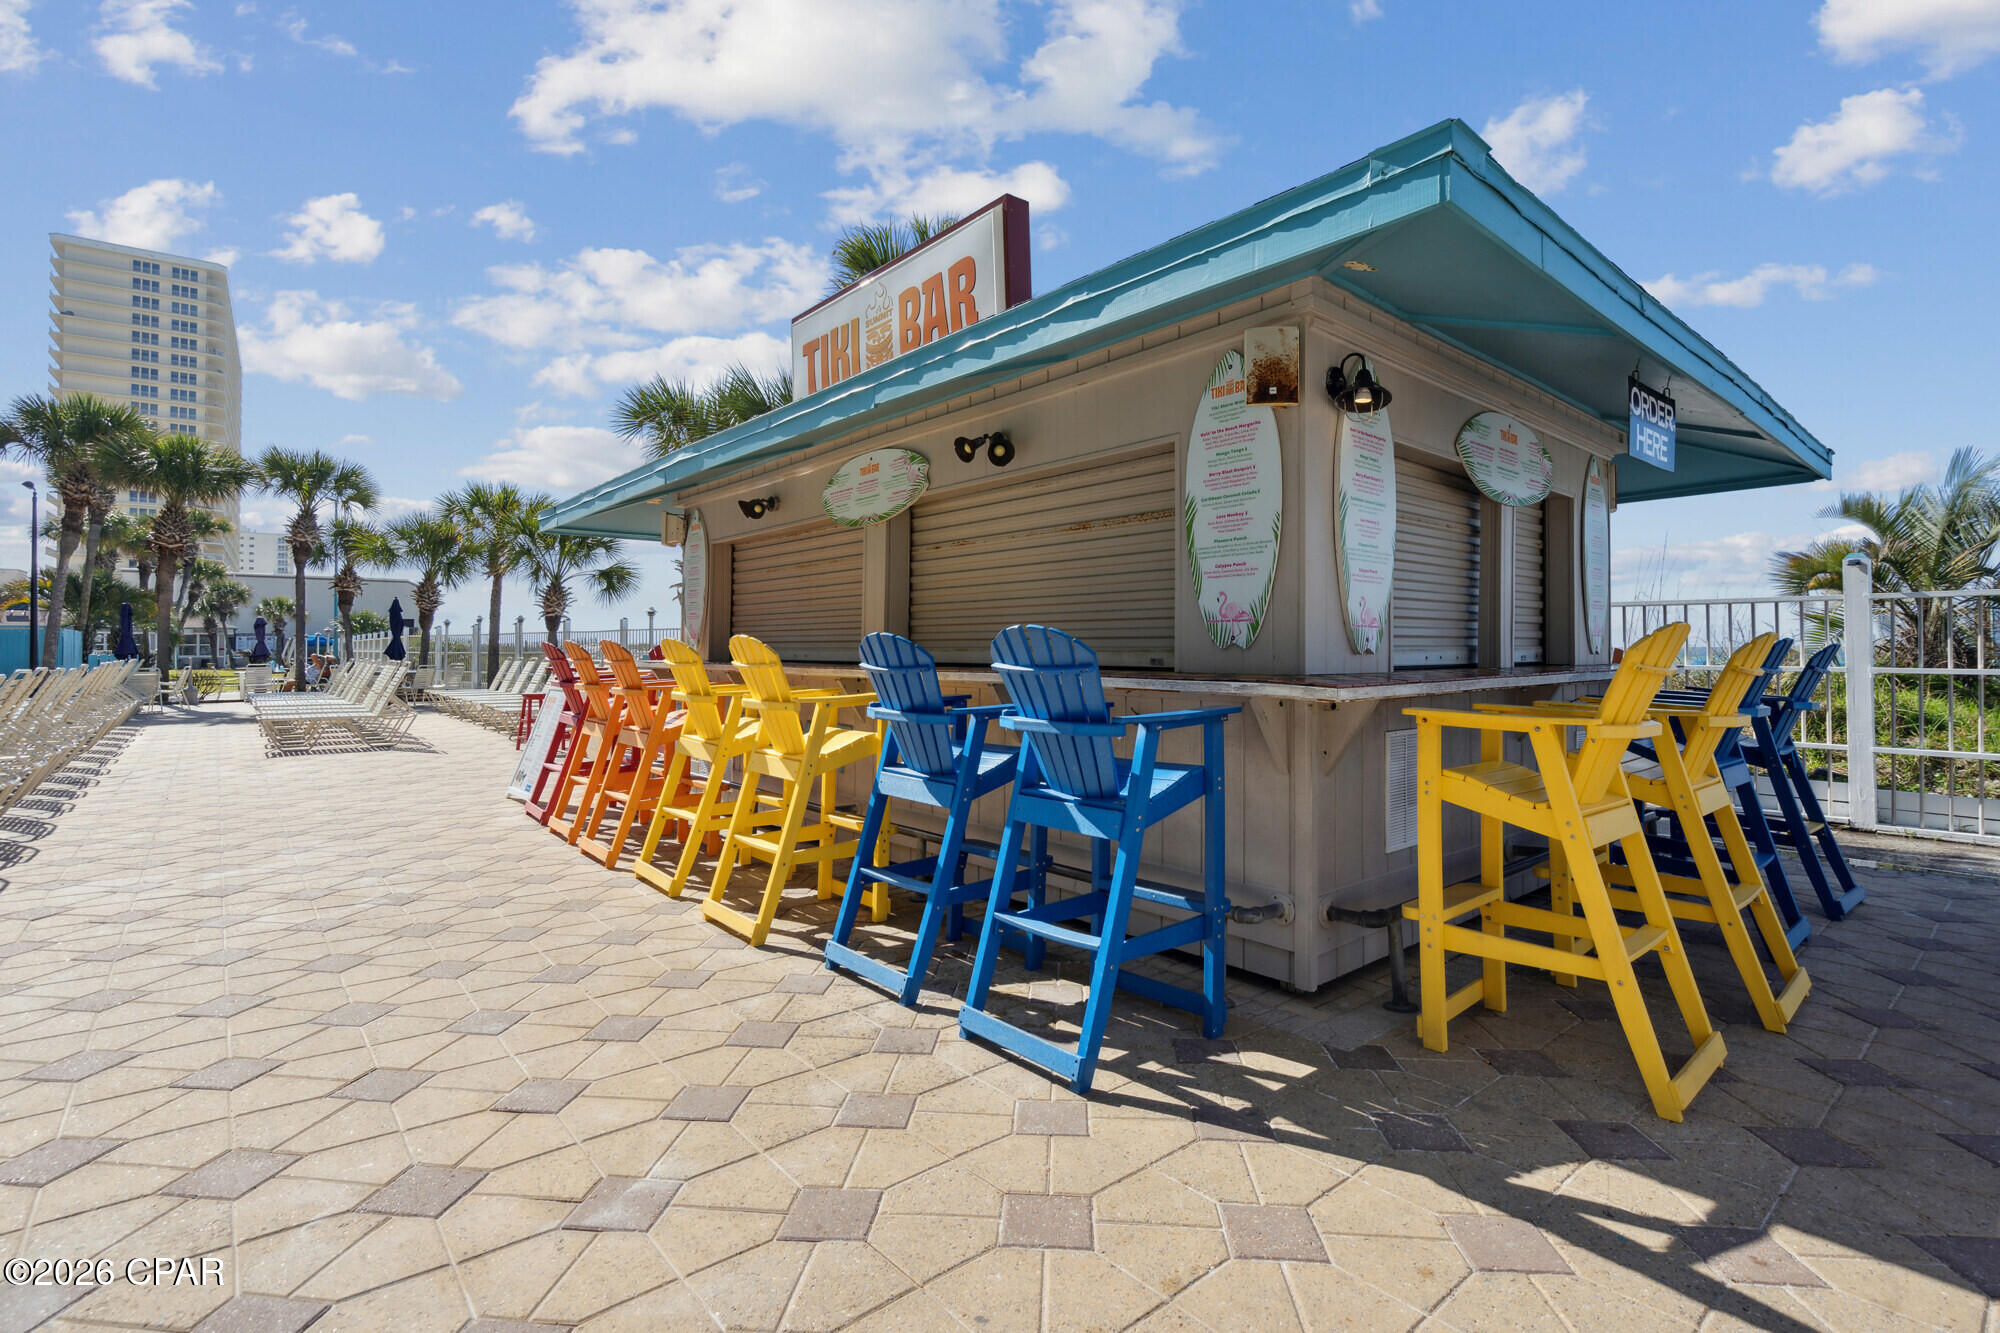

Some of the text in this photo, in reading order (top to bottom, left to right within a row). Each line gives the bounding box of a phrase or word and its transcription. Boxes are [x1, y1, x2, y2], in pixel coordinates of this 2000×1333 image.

[802, 255, 979, 395] TIKI BAR
[865, 308, 893, 328] SUMMIT
[1210, 380, 1245, 400] TIKI BA
[1630, 386, 1674, 432] ORDER
[1636, 423, 1668, 462] HERE
